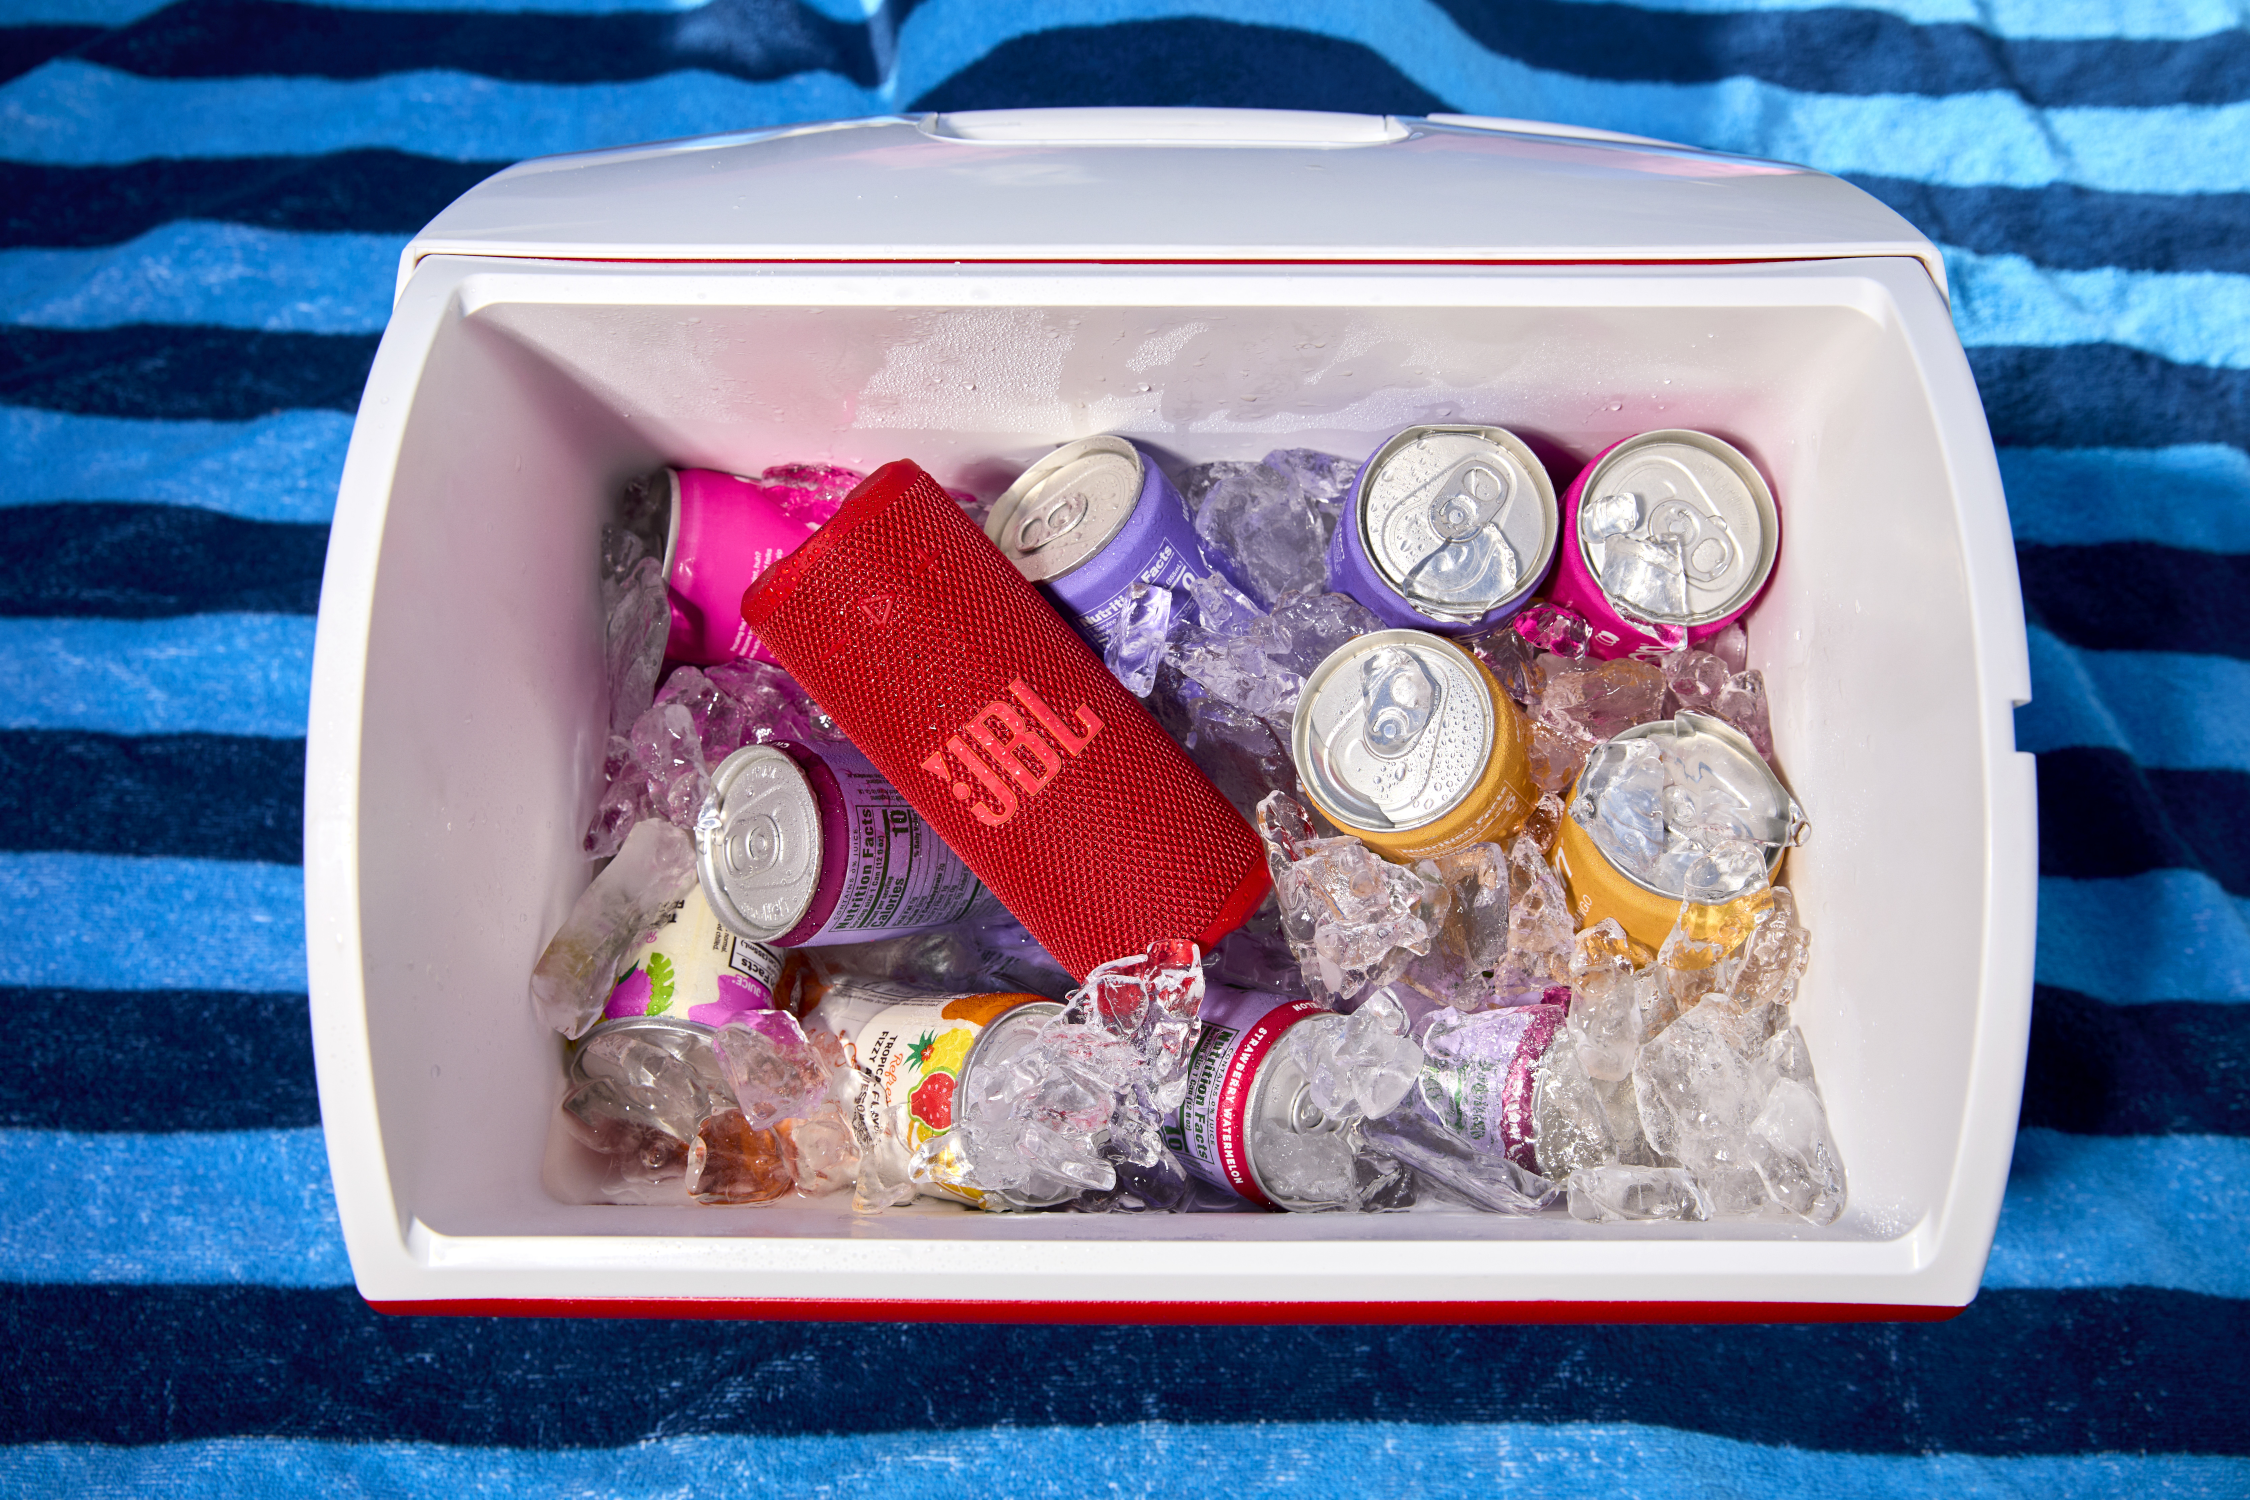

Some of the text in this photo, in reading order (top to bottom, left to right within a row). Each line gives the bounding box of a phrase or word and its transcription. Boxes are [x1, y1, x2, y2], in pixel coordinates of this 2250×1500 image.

[753, 551, 761, 568] huh?
[1164, 560, 1184, 585] (355mL)
[1079, 544, 1174, 627] Nutriti Facts
[945, 676, 1105, 826] JBL
[835, 807, 873, 929] Nutrition Facts
[870, 808, 909, 927] Calories 10
[875, 855, 883, 869] (12
[871, 871, 880, 886] Can
[876, 900, 885, 909] per
[881, 875, 894, 899] serving
[920, 872, 942, 913] Carbohydrate
[937, 862, 945, 871] 2g
[957, 872, 968, 891] Added
[832, 877, 854, 920] CONTAINS
[864, 893, 874, 907] size
[904, 904, 912, 914] Fat
[1572, 893, 1593, 930] MANGO
[711, 930, 722, 950] chilled.
[719, 932, 729, 953] normal.
[740, 958, 769, 983] Facts
[868, 1030, 888, 1062] FIZZY
[873, 1035, 898, 1086] TROPICA
[1212, 1047, 1234, 1096] CONTAINS
[1187, 1079, 1195, 1094] Can
[1195, 1031, 1232, 1159] Nutrition Facts
[1221, 1026, 1267, 1184] STRAWBERRY WATERMELON
[1163, 1125, 1184, 1152] 10
[1207, 1118, 1216, 1145] JUICE
